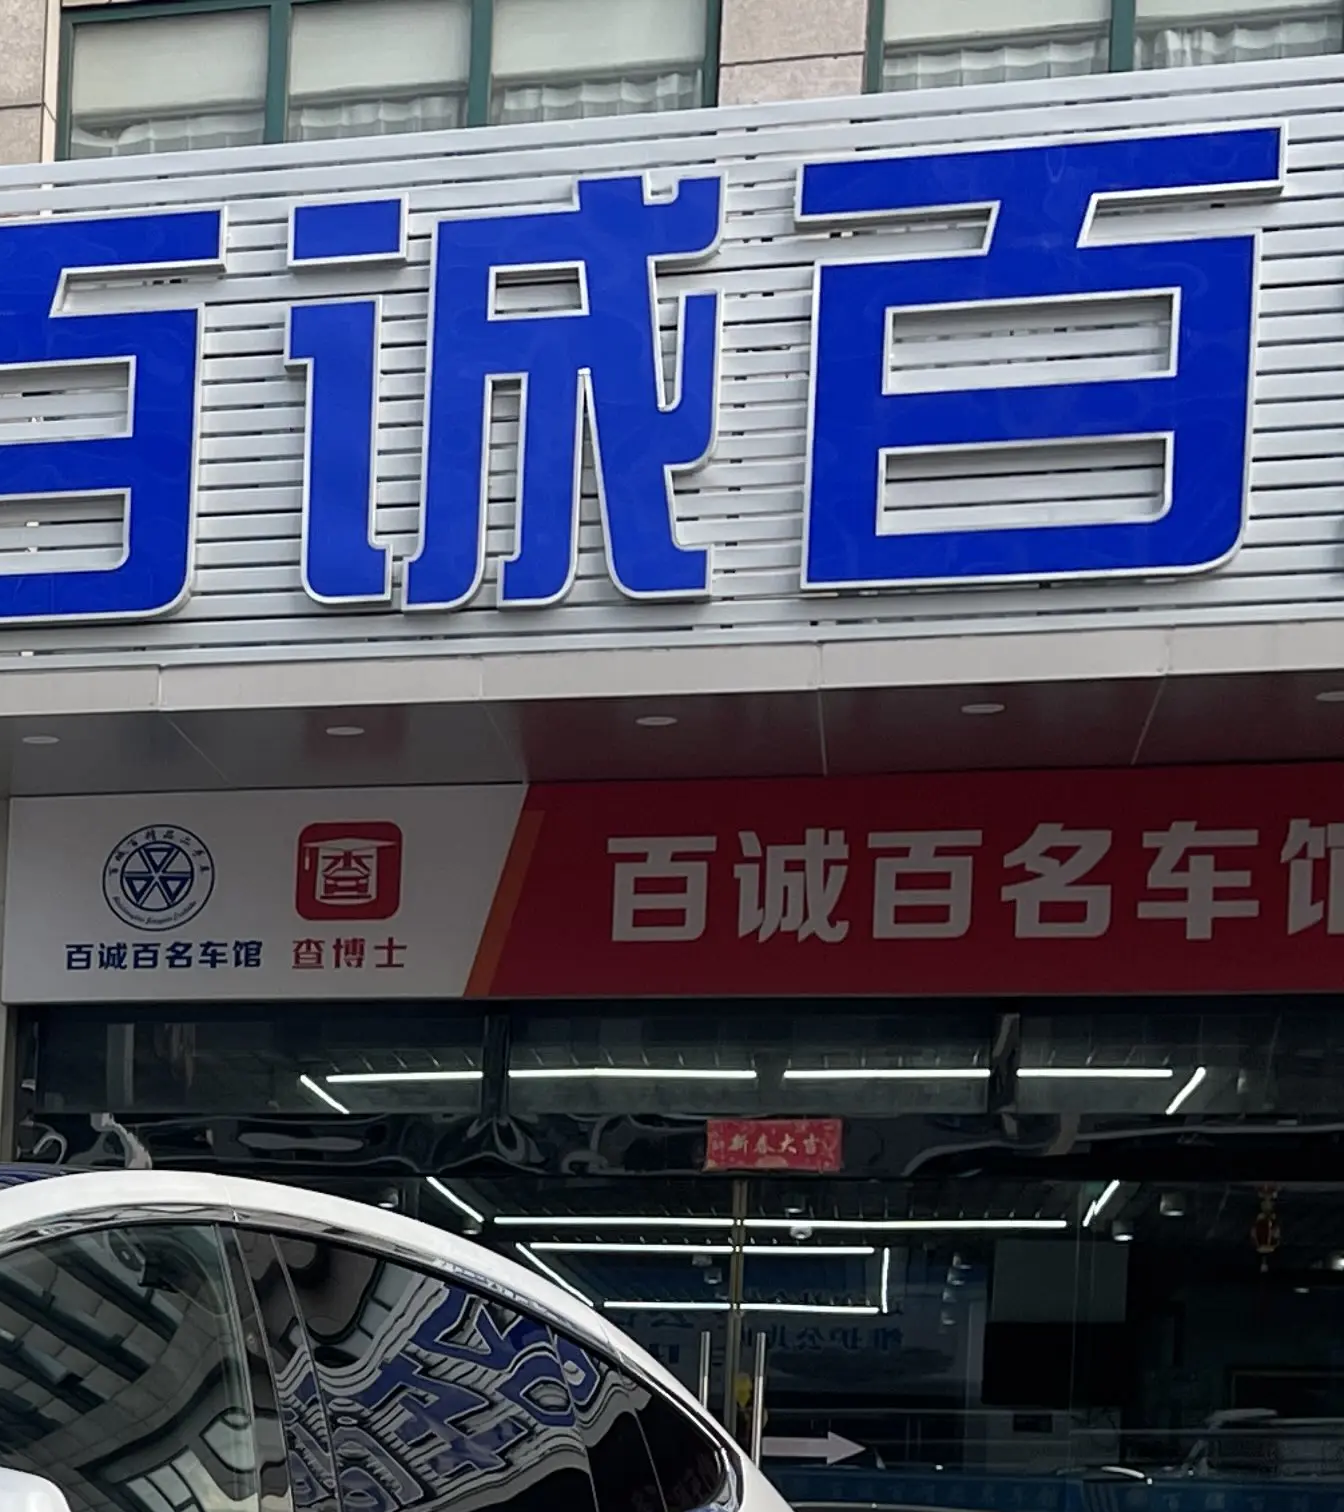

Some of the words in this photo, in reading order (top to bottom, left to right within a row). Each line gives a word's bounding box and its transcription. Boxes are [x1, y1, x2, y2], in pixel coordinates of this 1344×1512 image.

[65, 941, 263, 970] 百诚百名车馆
[291, 937, 408, 969] 查博士
